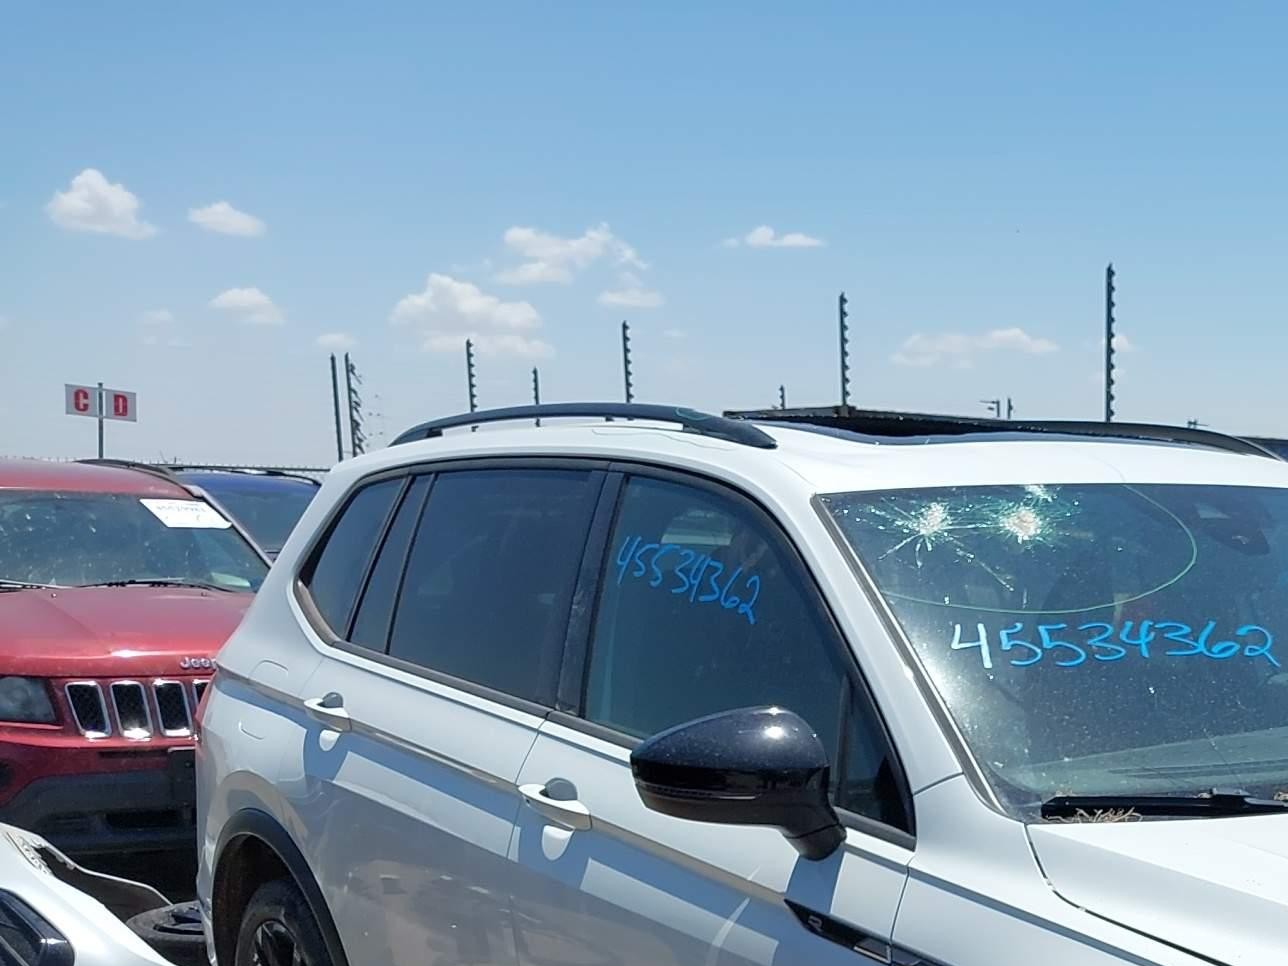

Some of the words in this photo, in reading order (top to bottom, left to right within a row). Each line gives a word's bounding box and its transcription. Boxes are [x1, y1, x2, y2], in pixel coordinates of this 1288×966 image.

[74, 389, 89, 412] C
[113, 394, 128, 417] D
[617, 536, 760, 625] 45534362
[950, 620, 1281, 668] 45534362
